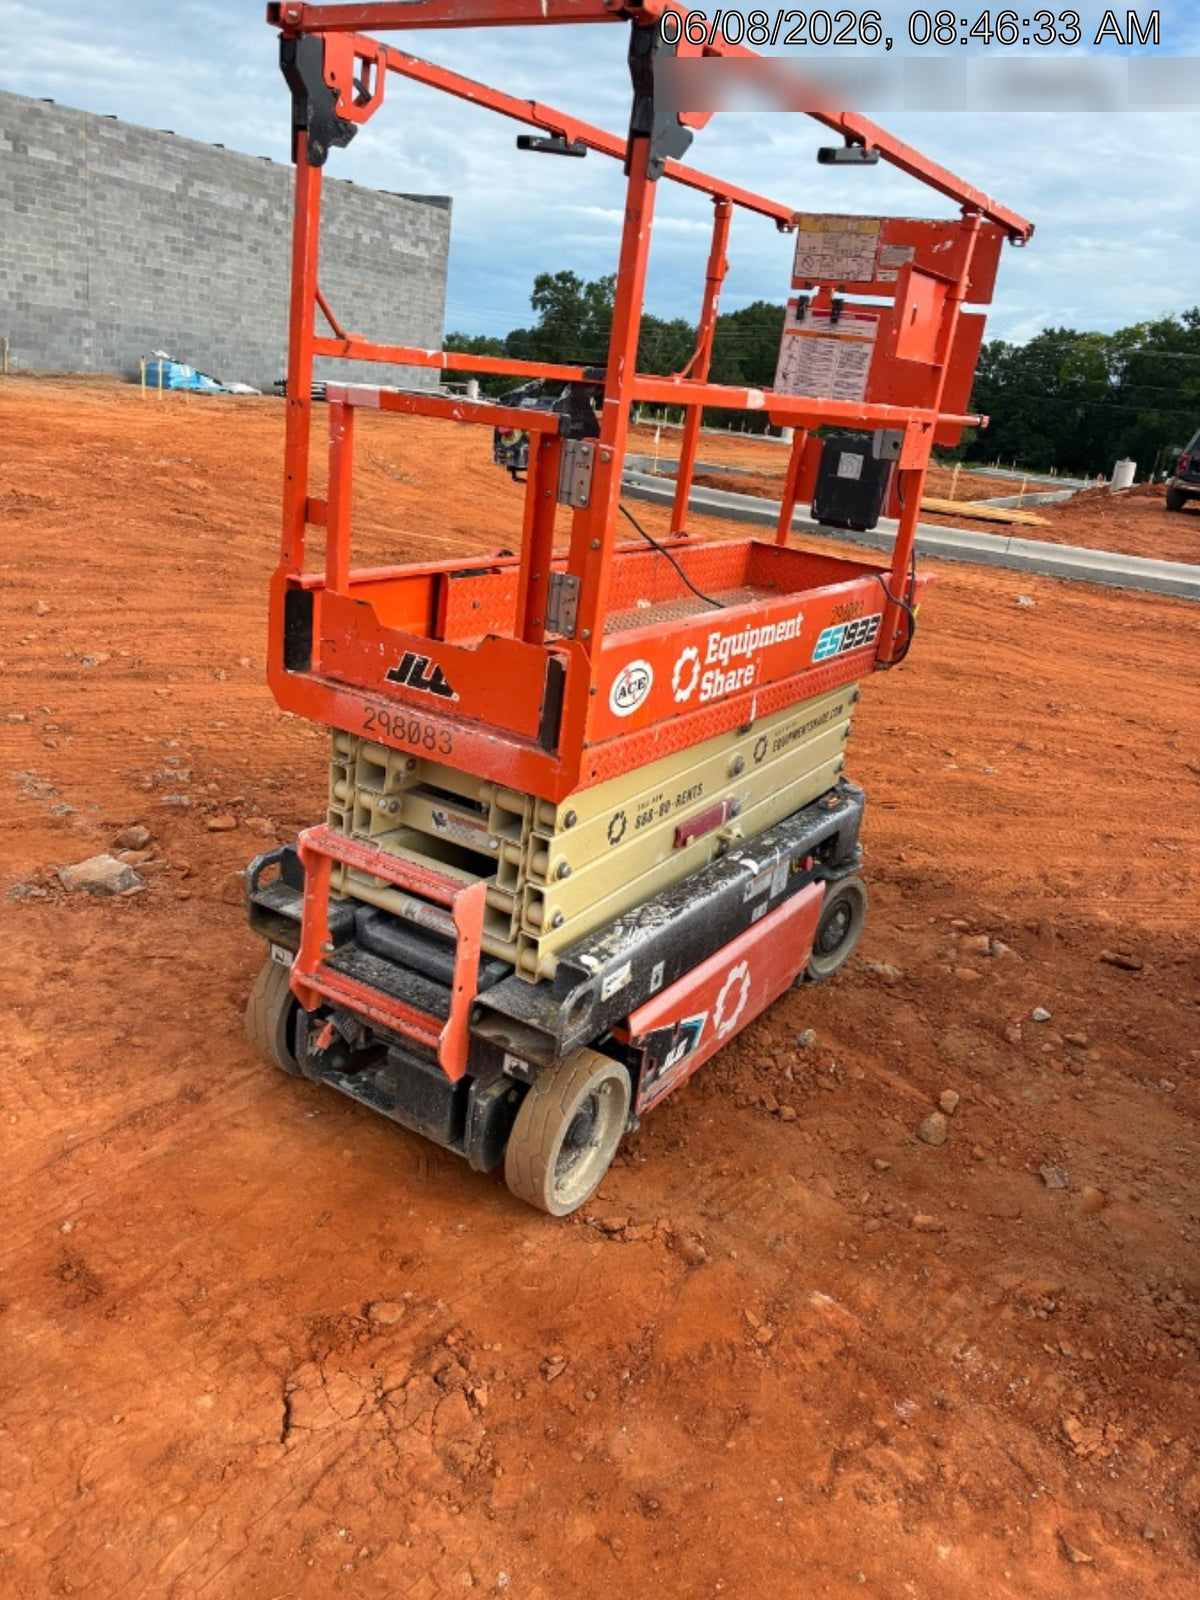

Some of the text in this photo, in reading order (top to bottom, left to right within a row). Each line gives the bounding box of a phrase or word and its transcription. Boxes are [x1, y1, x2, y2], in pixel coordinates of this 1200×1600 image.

[704, 612, 804, 666] Equipment
[813, 615, 881, 660] ES1932
[618, 677, 647, 700] ACE
[699, 663, 755, 702] Share
[362, 705, 453, 755] 298083
[659, 1037, 689, 1075] JLG
